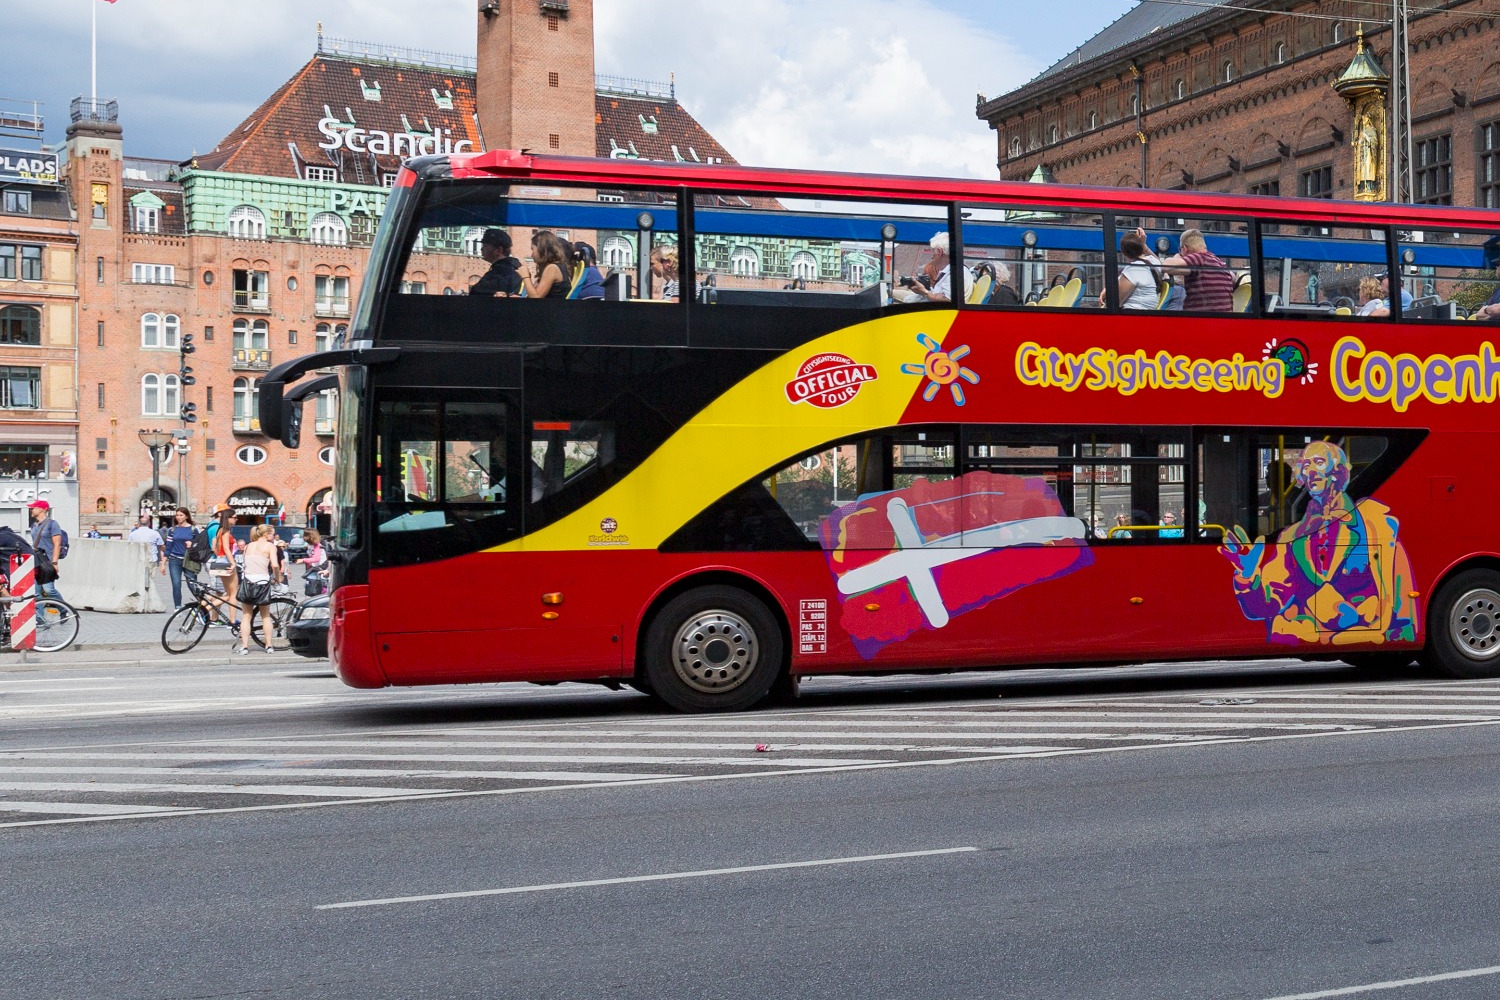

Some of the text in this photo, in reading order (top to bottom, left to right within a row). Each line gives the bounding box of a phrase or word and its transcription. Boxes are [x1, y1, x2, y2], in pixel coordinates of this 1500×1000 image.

[318, 118, 473, 156] Scandic
[803, 355, 851, 374] CITYSIGHTSEEING
[1015, 341, 1285, 398] CitySightseeing
[794, 366, 874, 397] OFFICIAL
[820, 386, 856, 404] TOUR
[1, 487, 52, 502] KFC
[229, 496, 265, 506] Believe
